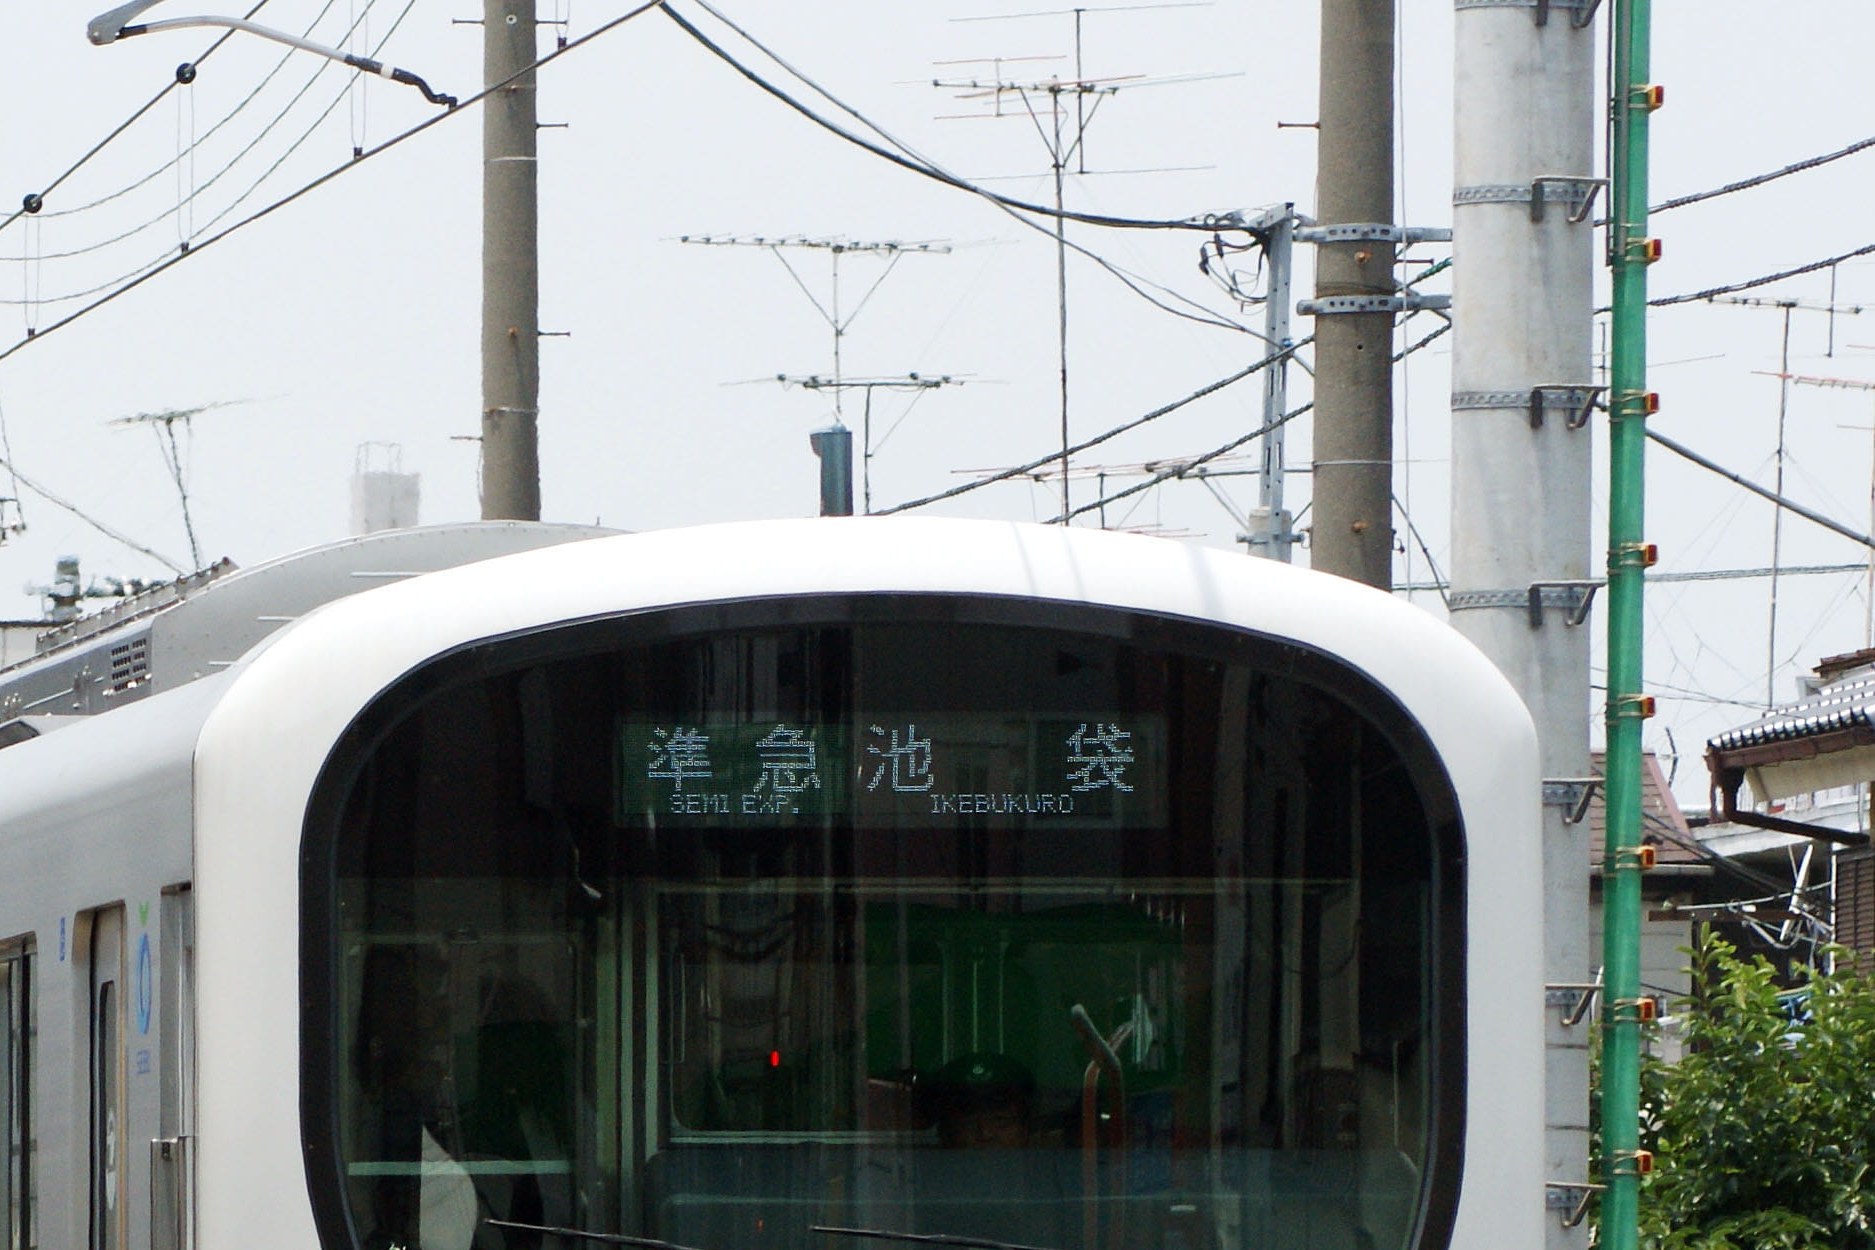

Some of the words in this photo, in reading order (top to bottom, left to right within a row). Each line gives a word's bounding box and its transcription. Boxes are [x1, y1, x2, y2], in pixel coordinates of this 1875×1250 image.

[647, 723, 822, 792] 準急
[859, 723, 1135, 792] 池袋
[670, 793, 730, 814] SEMI
[742, 793, 800, 814] EXP.
[930, 793, 1075, 814] IKEBUKURO
